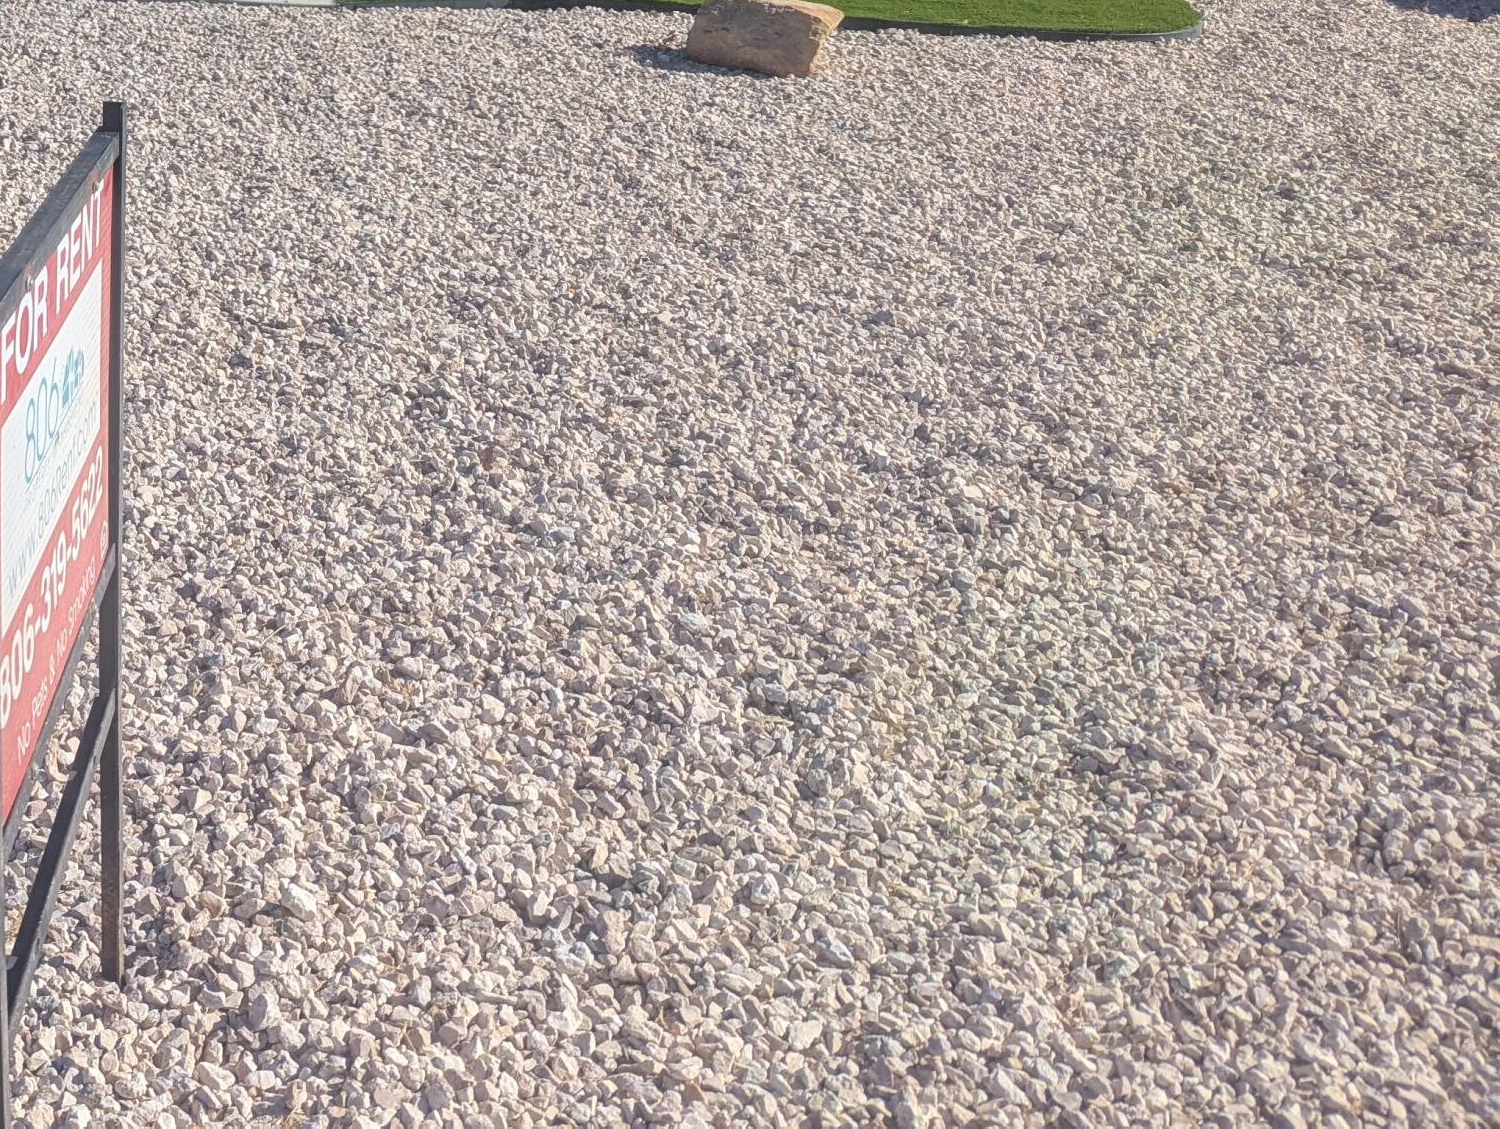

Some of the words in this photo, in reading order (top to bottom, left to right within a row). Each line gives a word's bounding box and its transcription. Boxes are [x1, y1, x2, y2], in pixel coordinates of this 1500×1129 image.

[1, 265, 48, 405] FOR
[56, 180, 104, 314] RENT
[8, 401, 96, 597] www.806Rent.com
[25, 356, 59, 484] 806
[0, 445, 103, 729] 806-319-5622
[17, 723, 31, 764] No
[31, 677, 48, 727] Pets
[49, 654, 56, 684] &
[56, 628, 68, 661] No
[68, 557, 96, 636] Smoking
